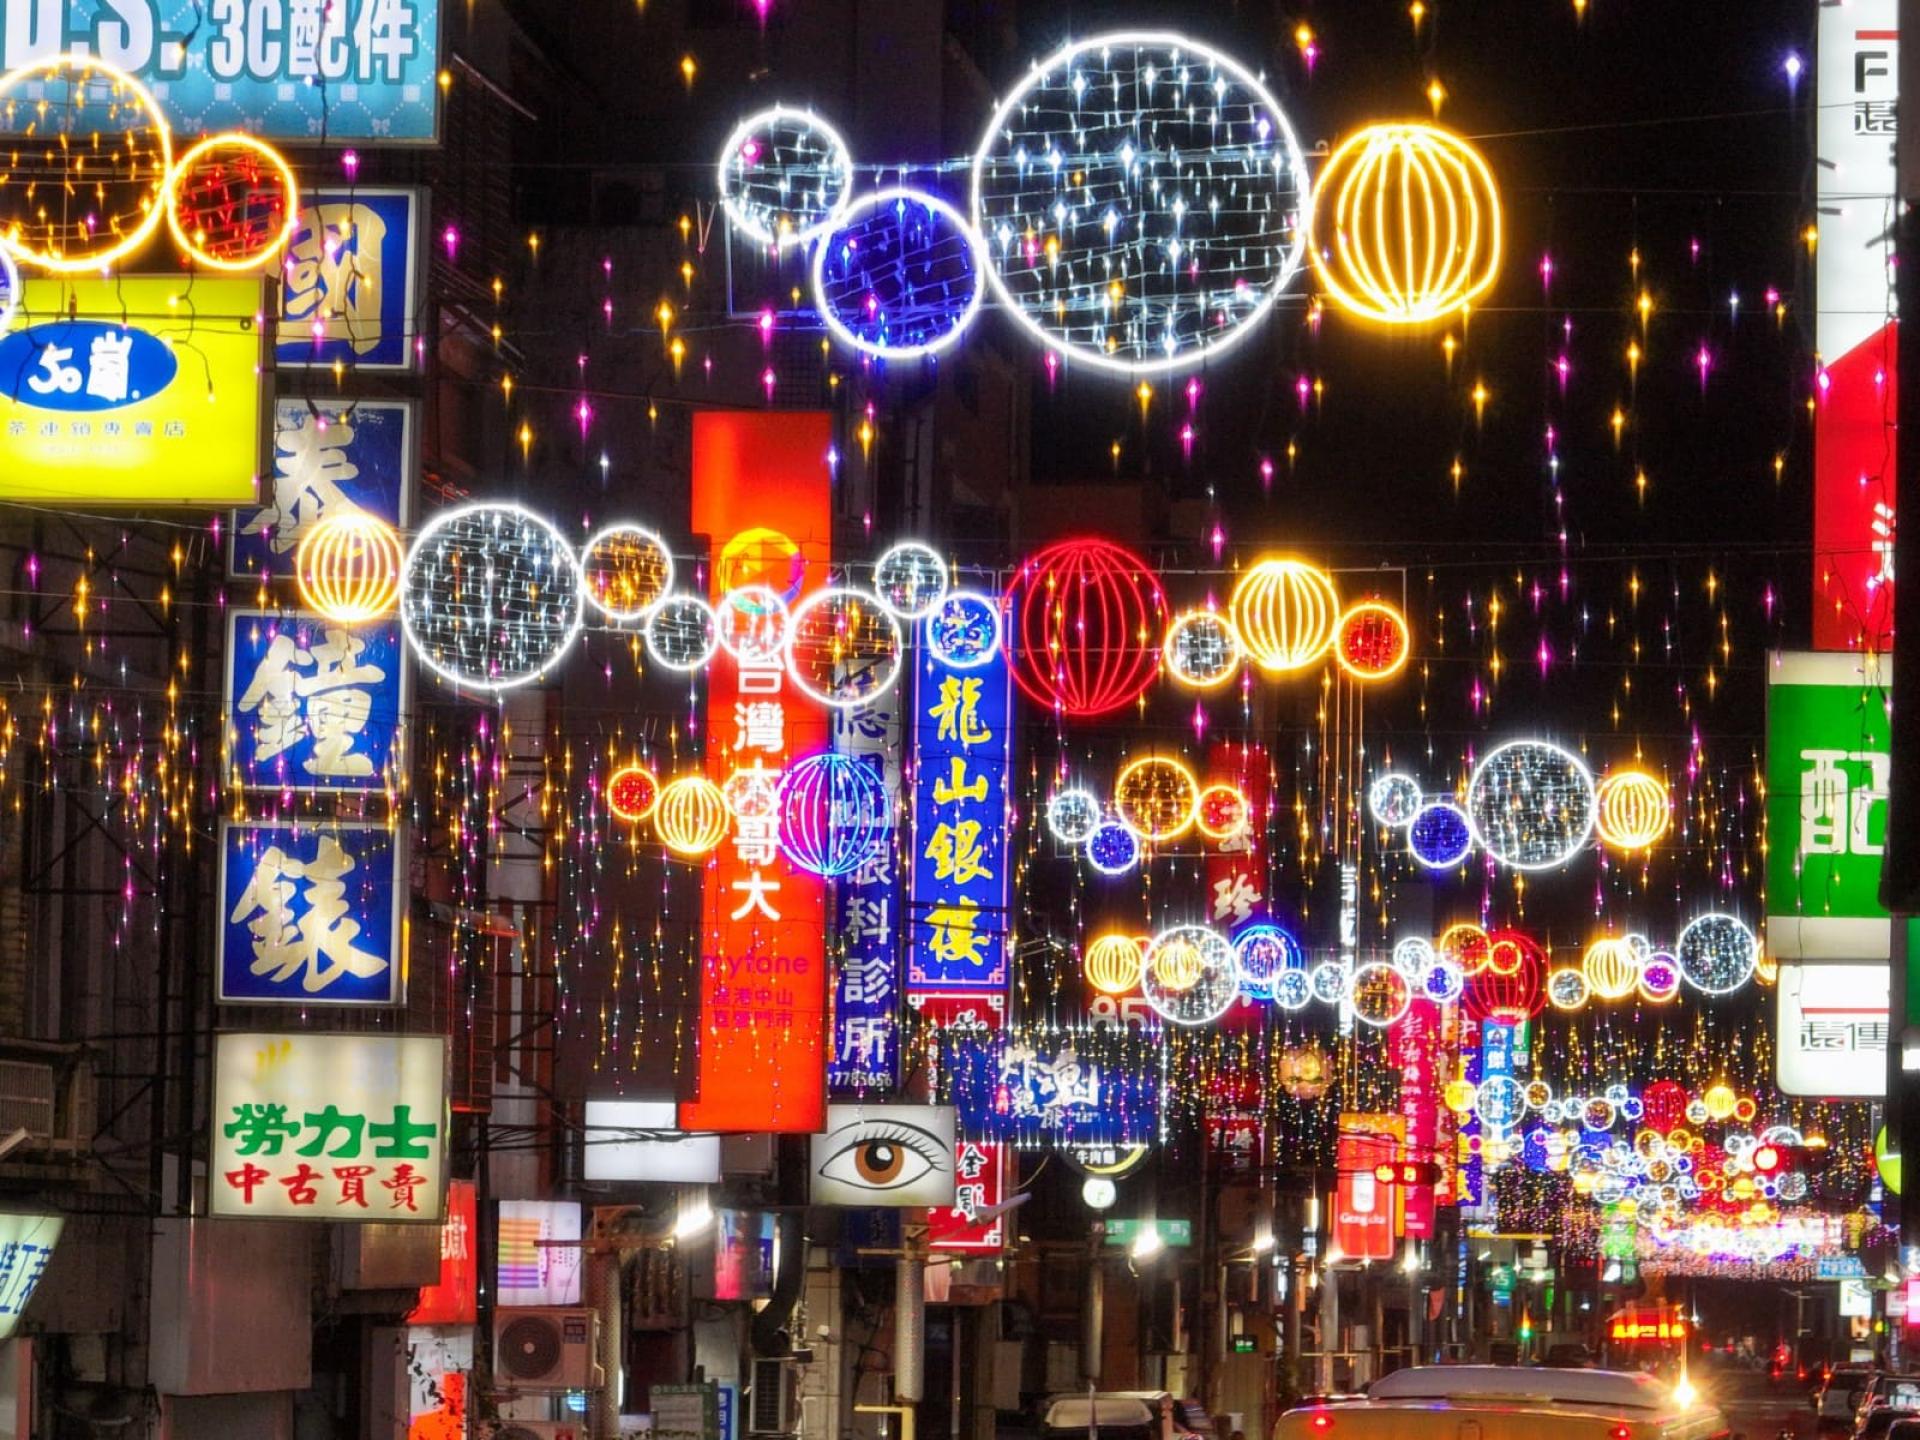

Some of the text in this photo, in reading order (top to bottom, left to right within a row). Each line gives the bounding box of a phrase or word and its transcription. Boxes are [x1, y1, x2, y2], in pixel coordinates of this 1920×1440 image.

[212, 0, 413, 79] 3C配件
[731, 636, 785, 921] 台灣大哥大
[924, 674, 994, 966] 龍山銀樓
[702, 953, 810, 980] myfone
[223, 1103, 437, 1159] 勞力士
[225, 1163, 428, 1212] 中古買賣
